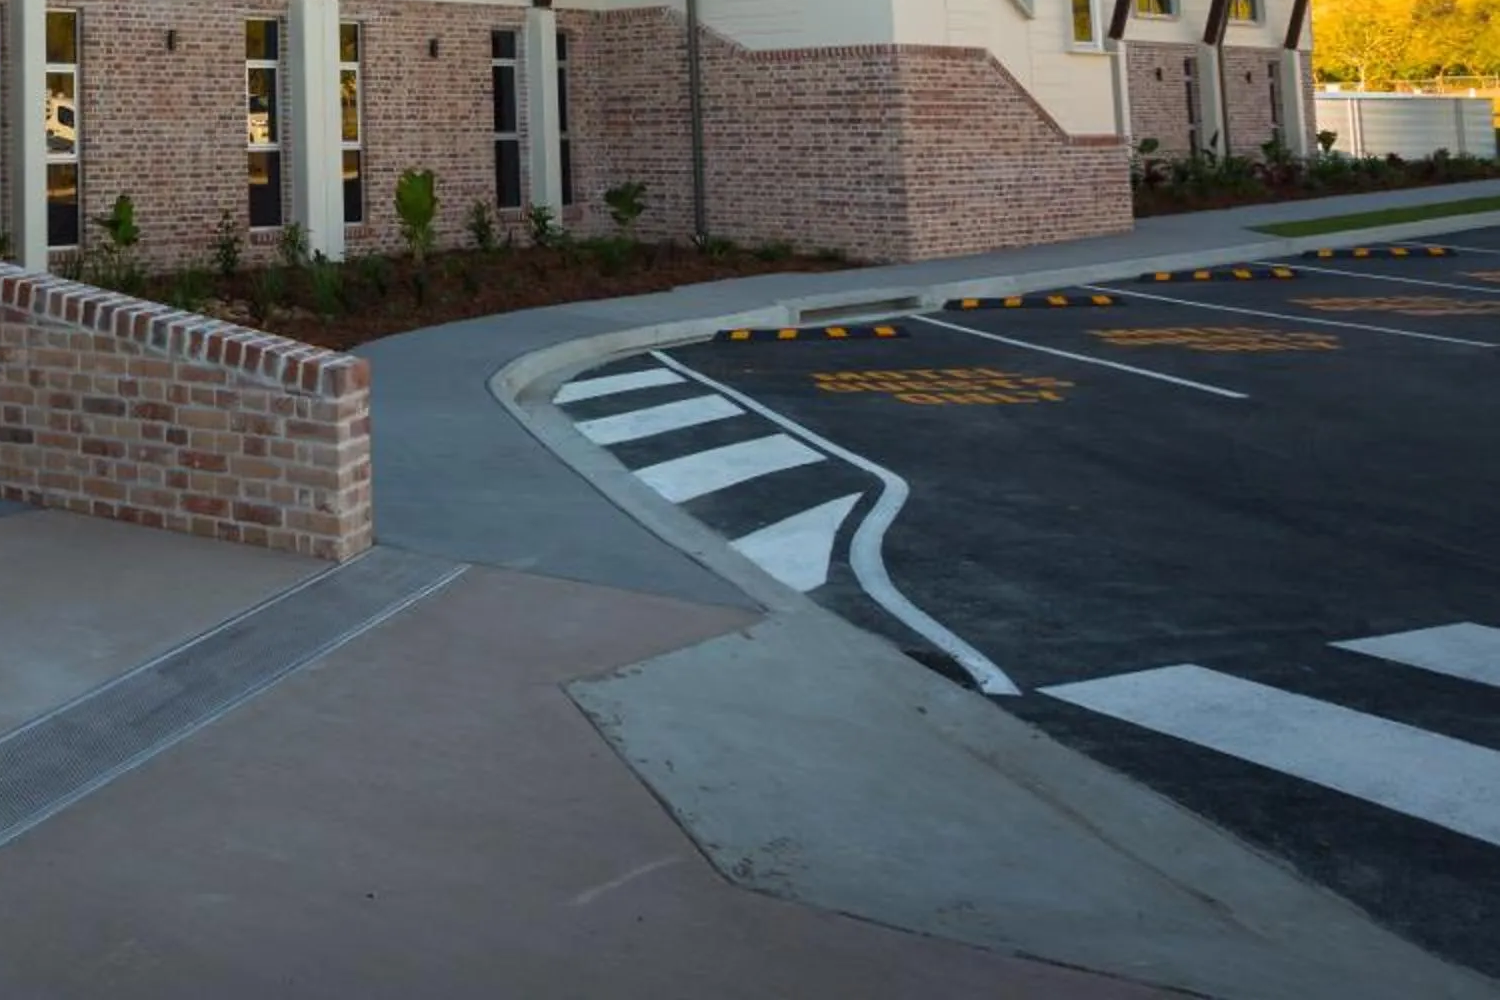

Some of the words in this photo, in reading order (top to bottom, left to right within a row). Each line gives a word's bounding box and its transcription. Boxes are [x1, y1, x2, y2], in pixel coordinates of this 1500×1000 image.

[811, 368, 1022, 380] MOTEL
[815, 377, 1075, 392] GUESTS
[895, 389, 1065, 404] ONLY
